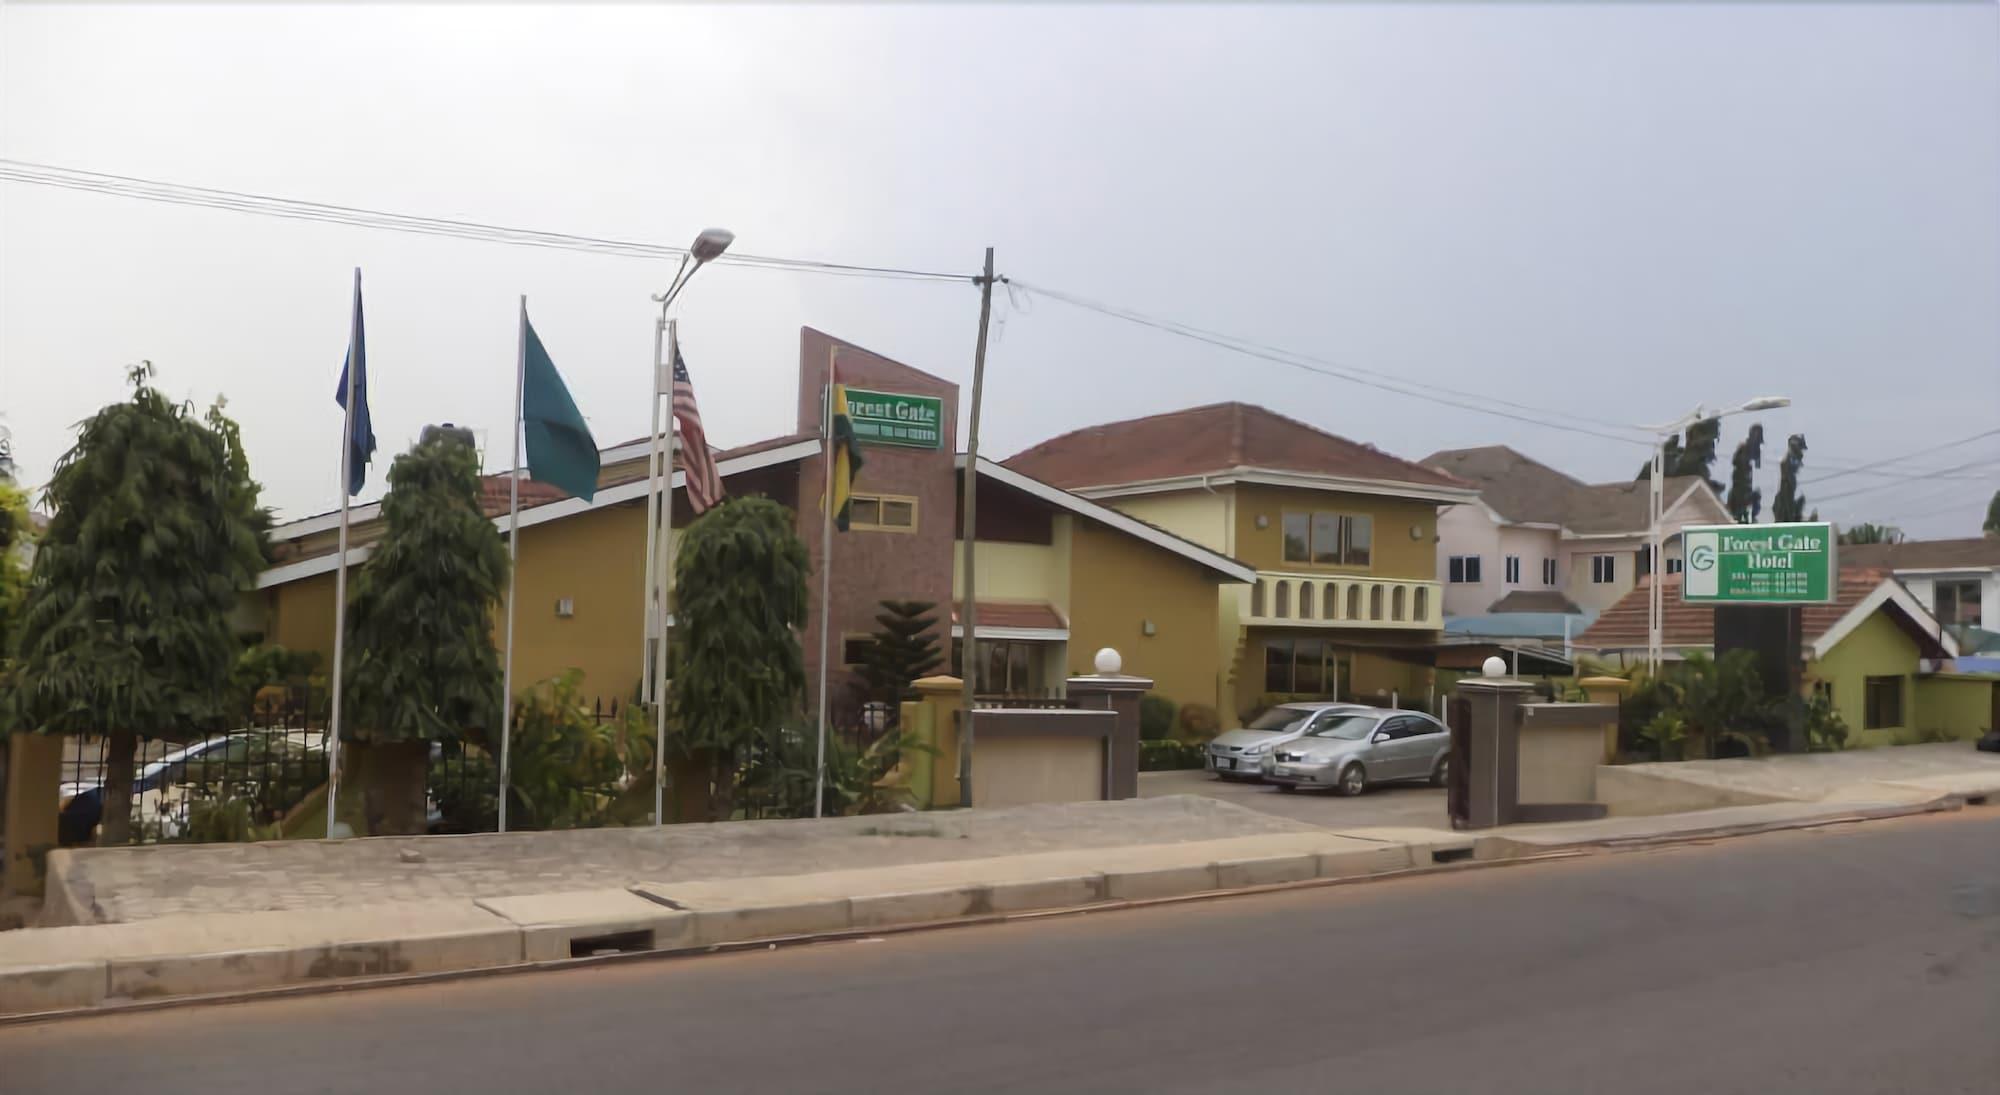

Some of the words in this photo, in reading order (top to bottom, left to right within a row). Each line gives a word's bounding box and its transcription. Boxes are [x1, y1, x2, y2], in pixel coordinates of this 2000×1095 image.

[896, 401, 936, 421] Gate
[1724, 536, 1772, 552] Forest
[1778, 534, 1821, 550] Gate
[1748, 552, 1792, 569] Hotel
